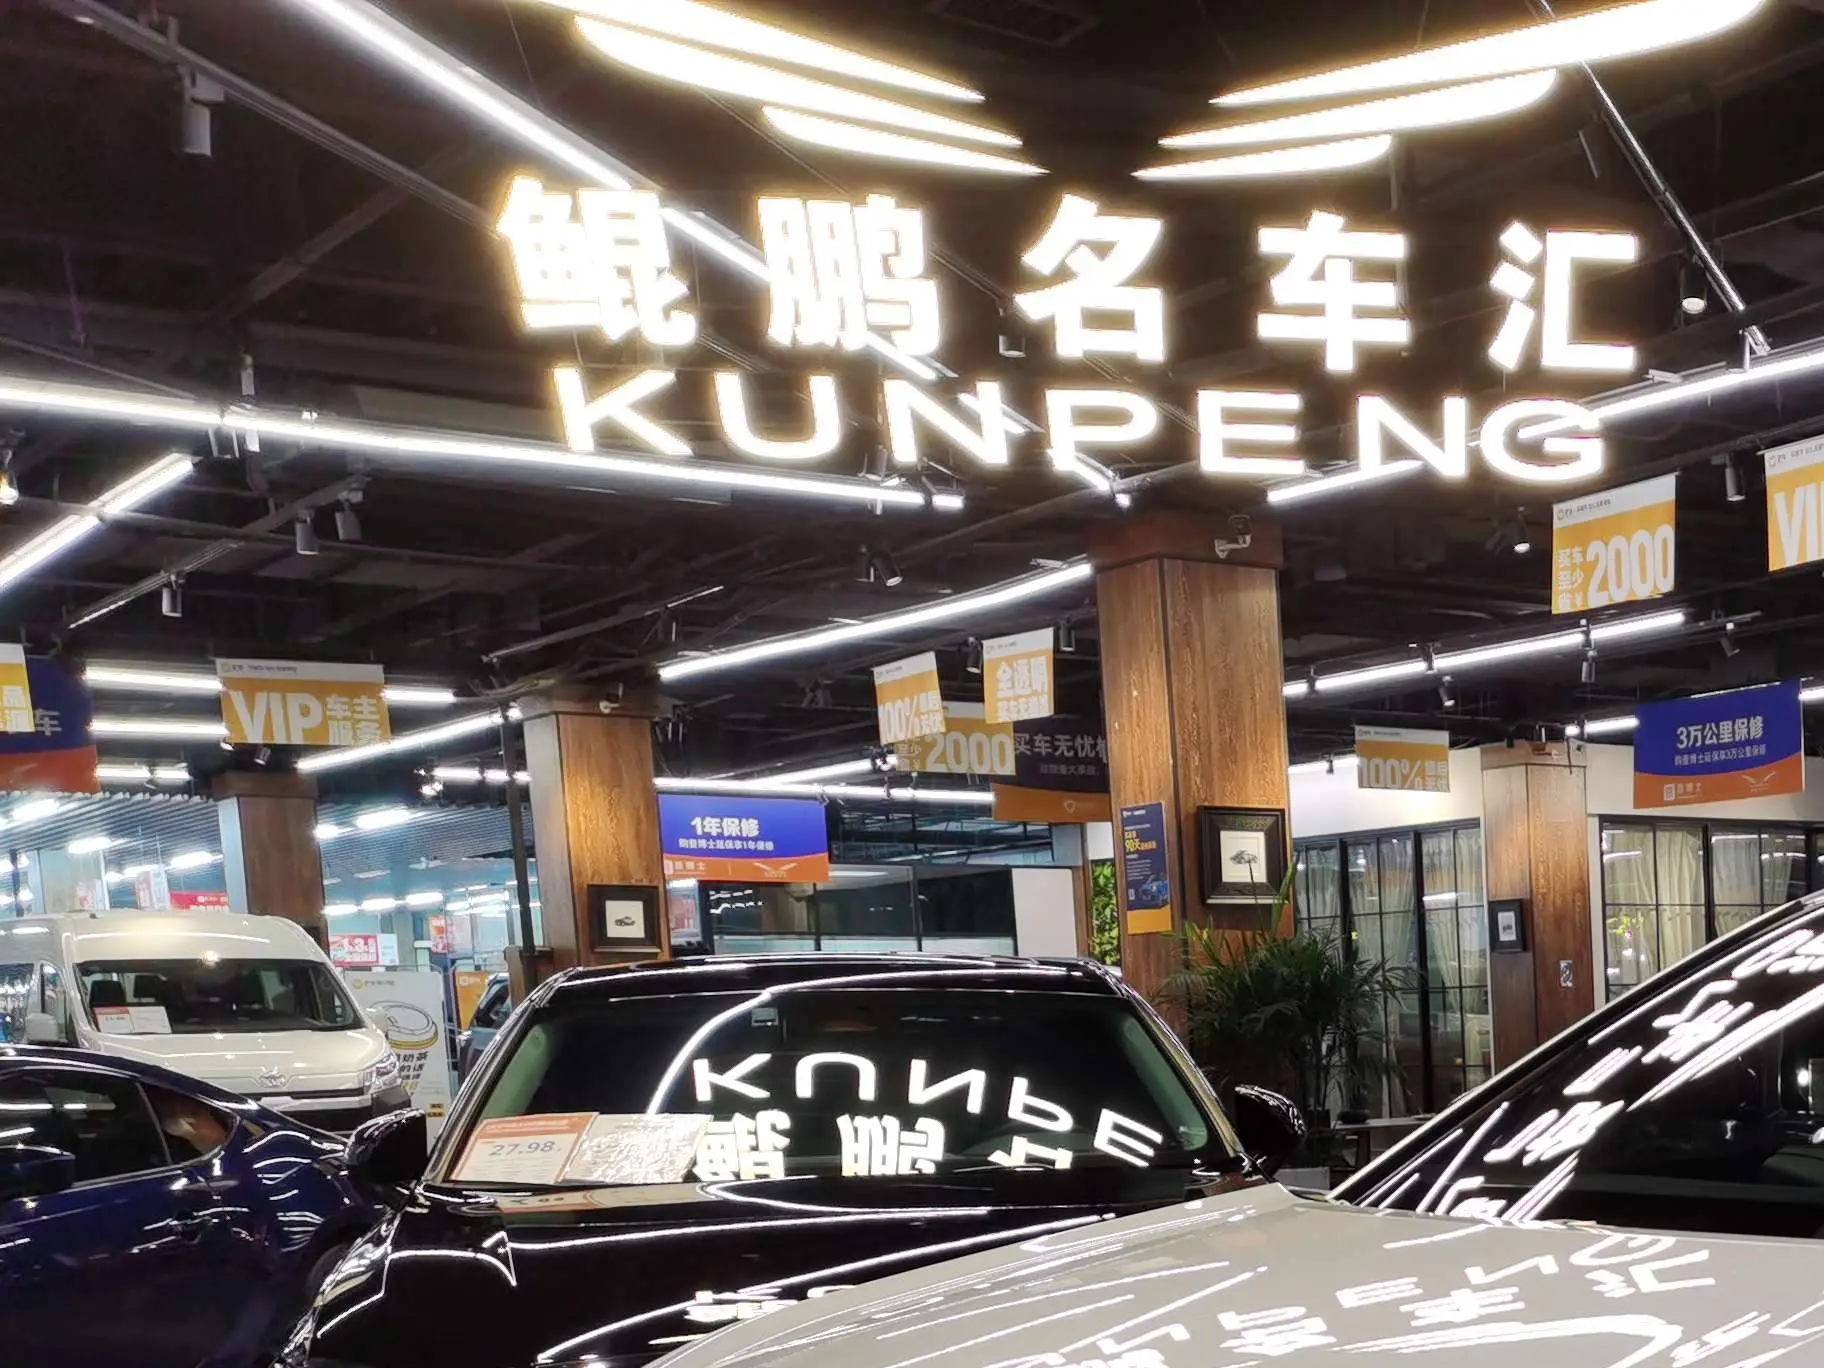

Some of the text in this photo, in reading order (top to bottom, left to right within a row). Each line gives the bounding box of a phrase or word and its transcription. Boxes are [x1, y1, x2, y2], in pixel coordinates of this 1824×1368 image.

[500, 176, 1638, 372] 鲲鹏名车汇
[553, 366, 1604, 482] KUNPENG
[1586, 523, 1675, 609] 2000
[229, 691, 322, 744] VIP
[325, 694, 380, 721] 车主
[925, 731, 1015, 775] 2000
[1675, 715, 1765, 750] 3万公里保修
[690, 816, 761, 838] 1年保修
